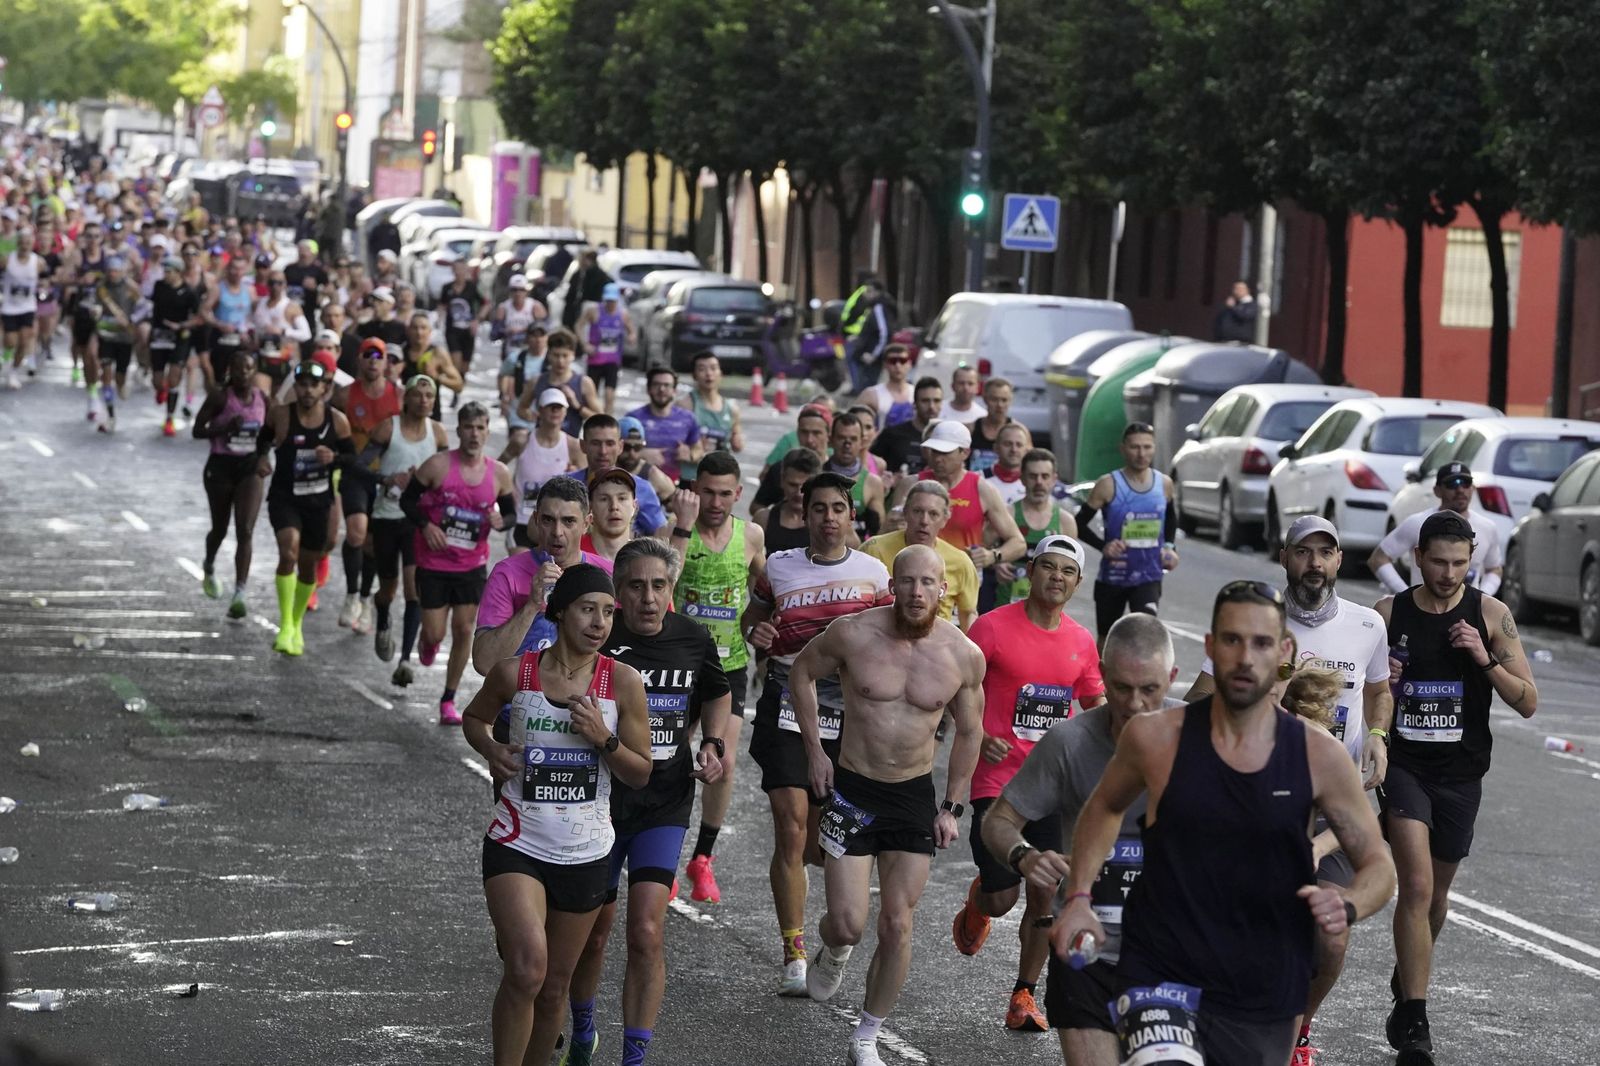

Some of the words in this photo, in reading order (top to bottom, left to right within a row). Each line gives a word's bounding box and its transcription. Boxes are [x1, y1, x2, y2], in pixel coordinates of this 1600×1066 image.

[780, 587, 861, 610] JARANA
[701, 608, 731, 618] ZURICH
[1314, 660, 1356, 672] STELERO
[1039, 688, 1067, 697] ZURICH
[1418, 685, 1455, 694] ZURICH
[1036, 704, 1054, 713] 4001
[1419, 703, 1439, 712] 4217
[648, 717, 664, 727] 226
[1403, 713, 1457, 728] RICARDO
[550, 752, 591, 762] ZURICH
[550, 772, 574, 782] 5127
[535, 786, 586, 801] ERICKA
[1127, 1024, 1194, 1055] JUANITO
